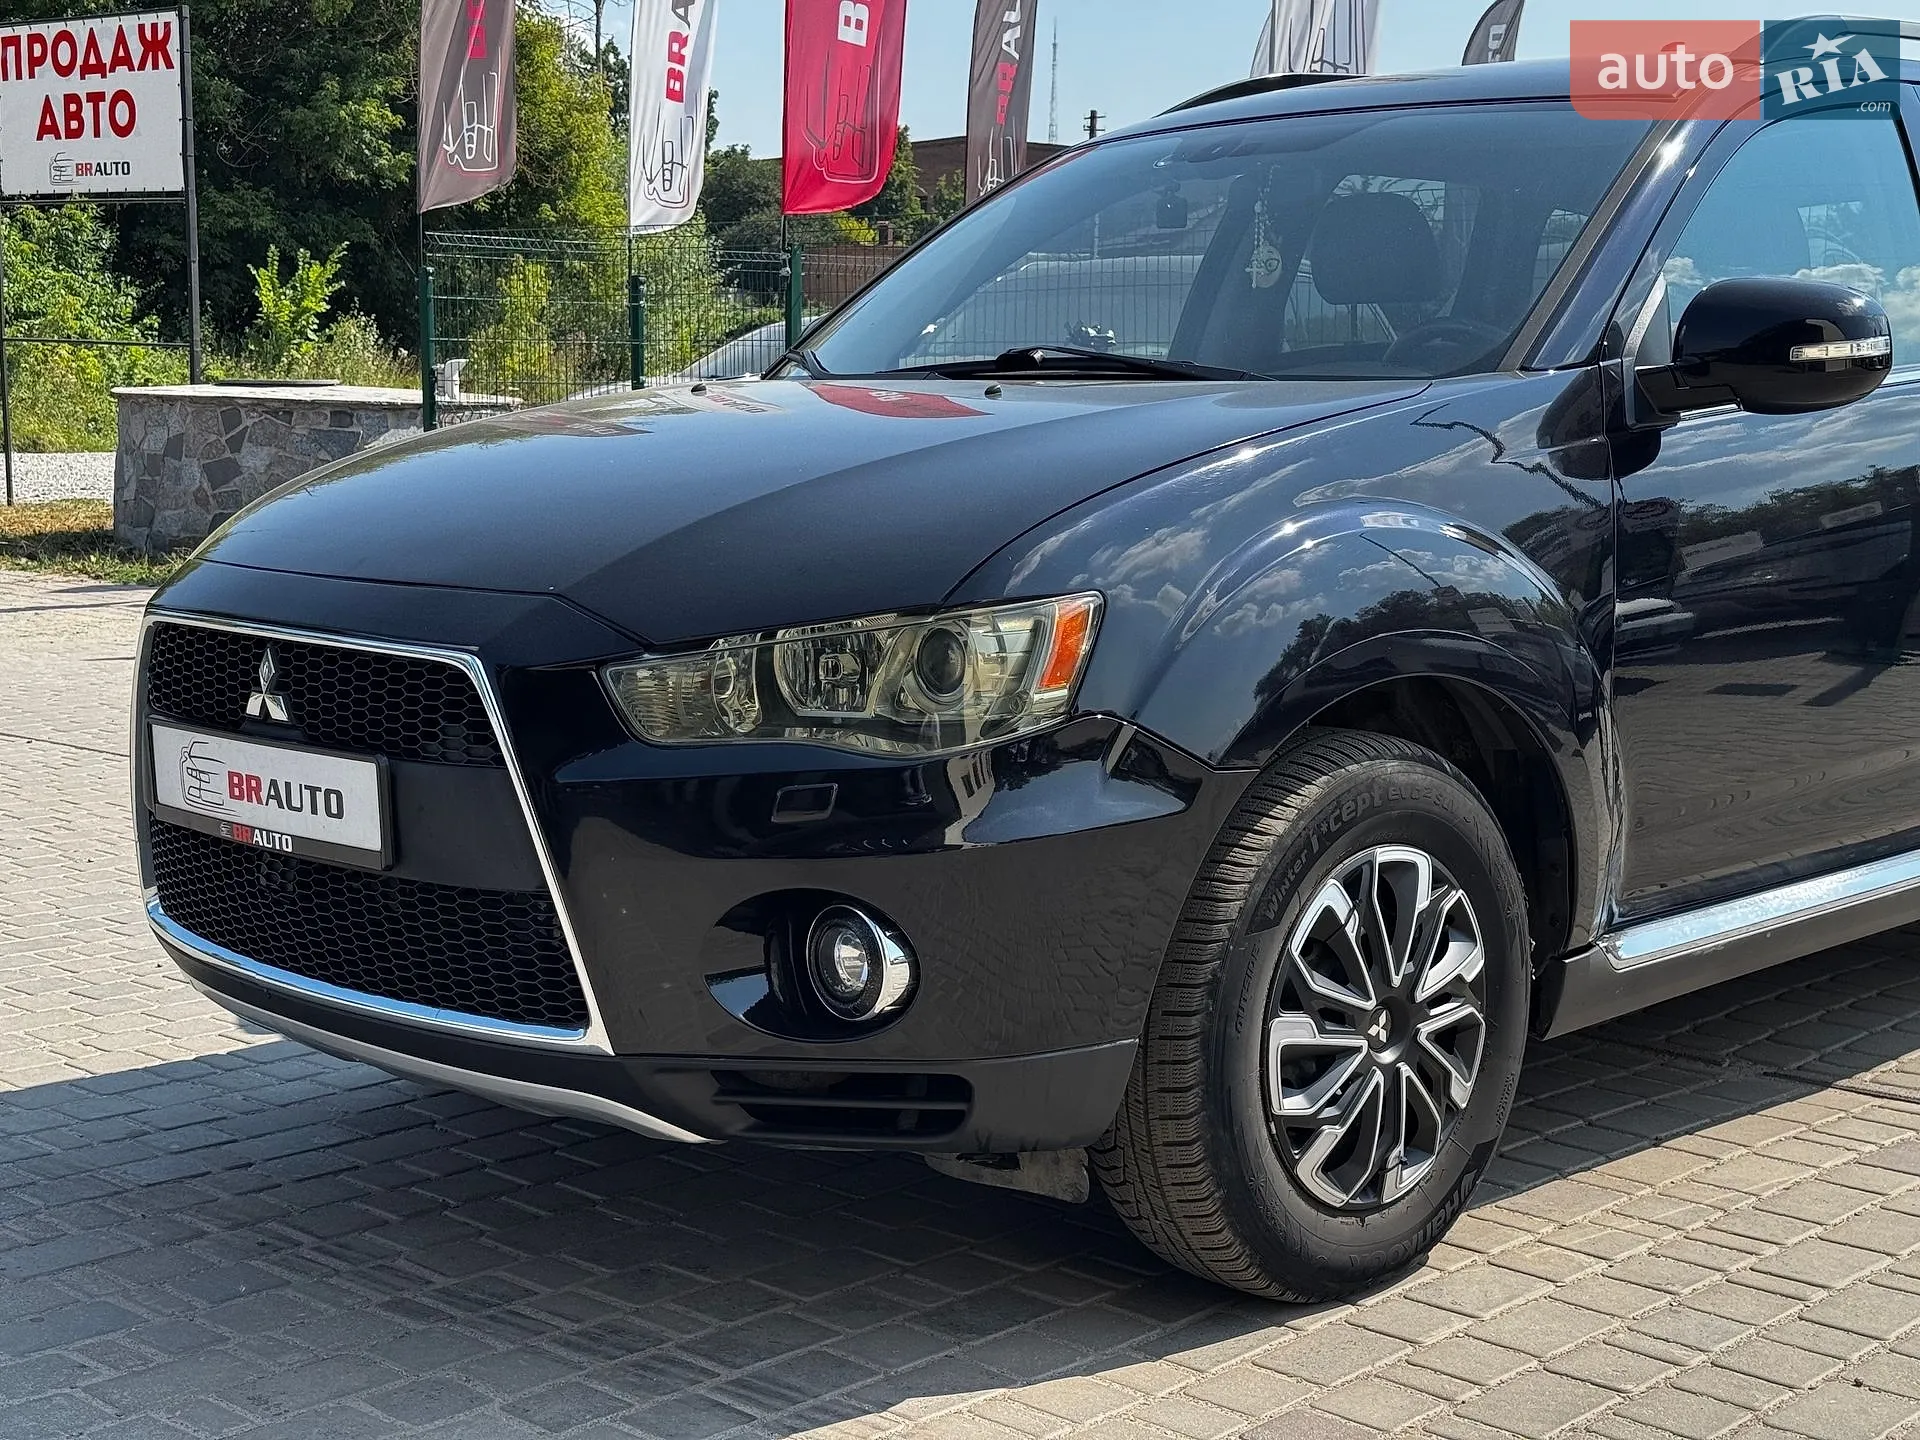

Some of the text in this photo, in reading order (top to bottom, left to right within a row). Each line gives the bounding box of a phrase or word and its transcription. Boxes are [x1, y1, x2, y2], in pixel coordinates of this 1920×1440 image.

[1, 21, 175, 81] ПРОДАЖ
[36, 88, 137, 141] АВТО
[75, 160, 131, 178] BRAUTO
[227, 770, 345, 819] BRAUTO
[232, 824, 293, 852] BRAUTO
